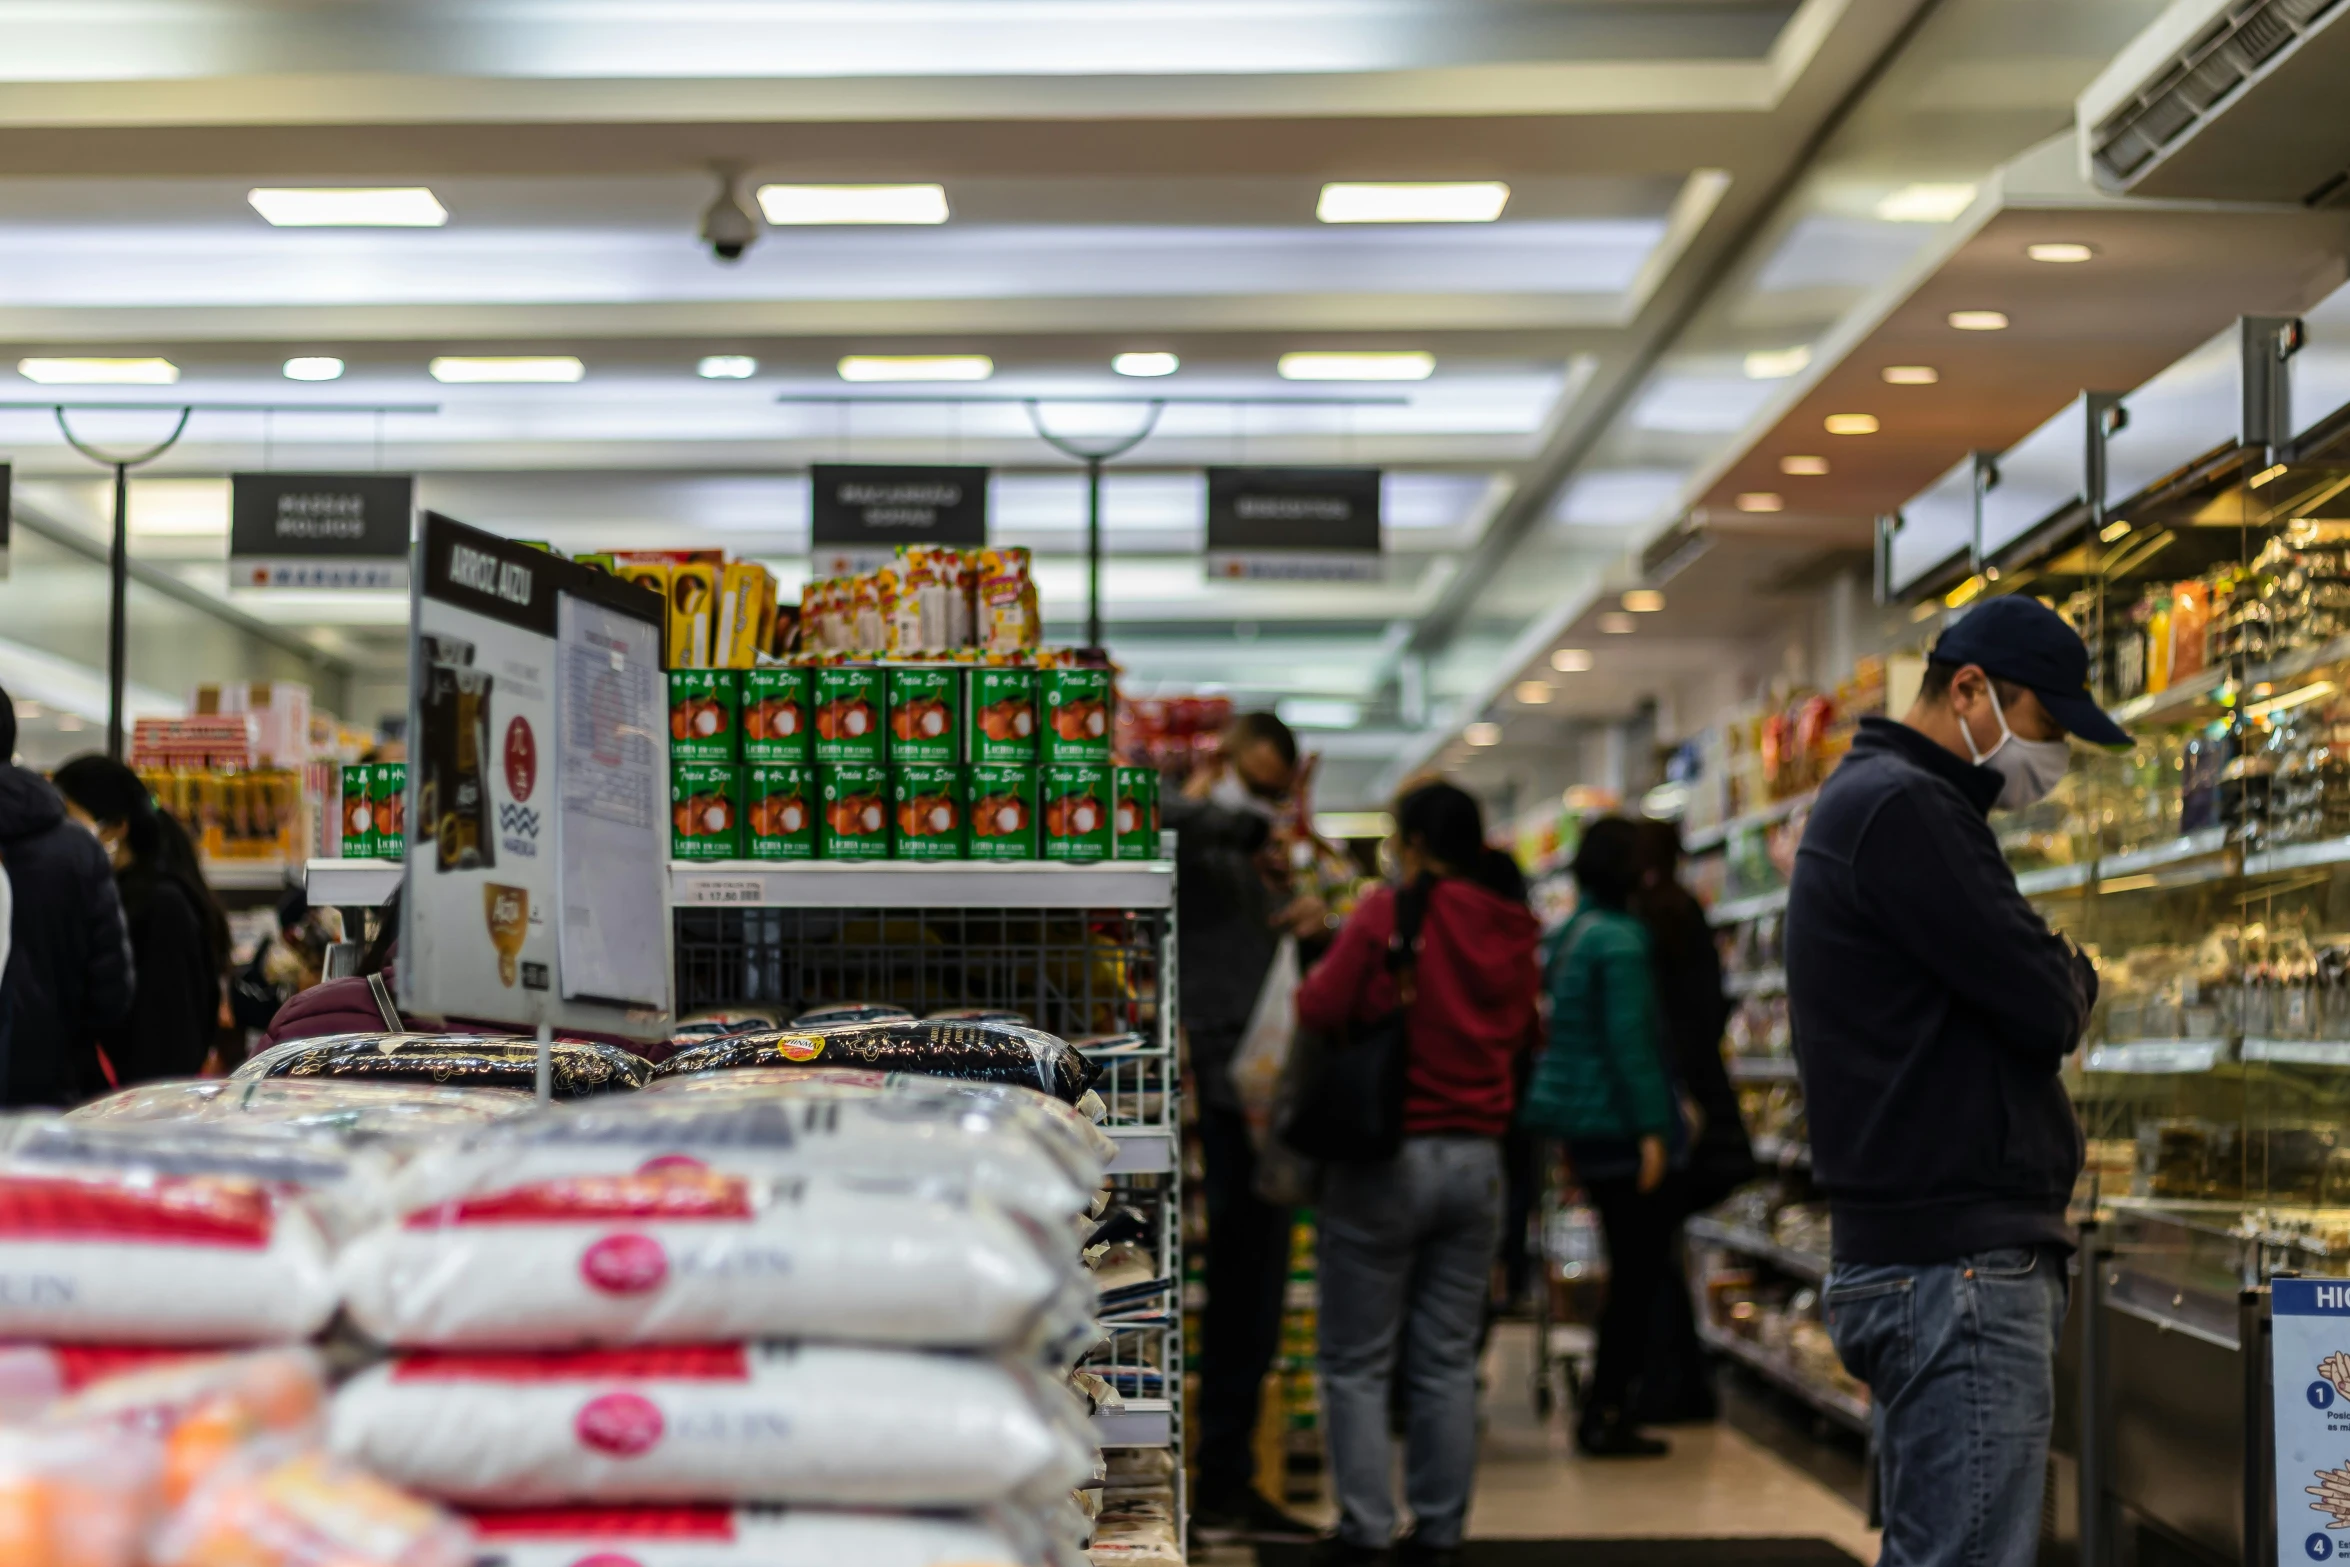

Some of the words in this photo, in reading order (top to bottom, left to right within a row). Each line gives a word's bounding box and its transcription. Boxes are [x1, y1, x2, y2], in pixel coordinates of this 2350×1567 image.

[448, 543, 498, 593] ARROZ
[499, 560, 533, 606] AIZU
[781, 1039, 821, 1050] SHINMAI
[2317, 1286, 2350, 1308] HI
[2316, 1387, 2324, 1403] 1
[2313, 1539, 2325, 1555] 4
